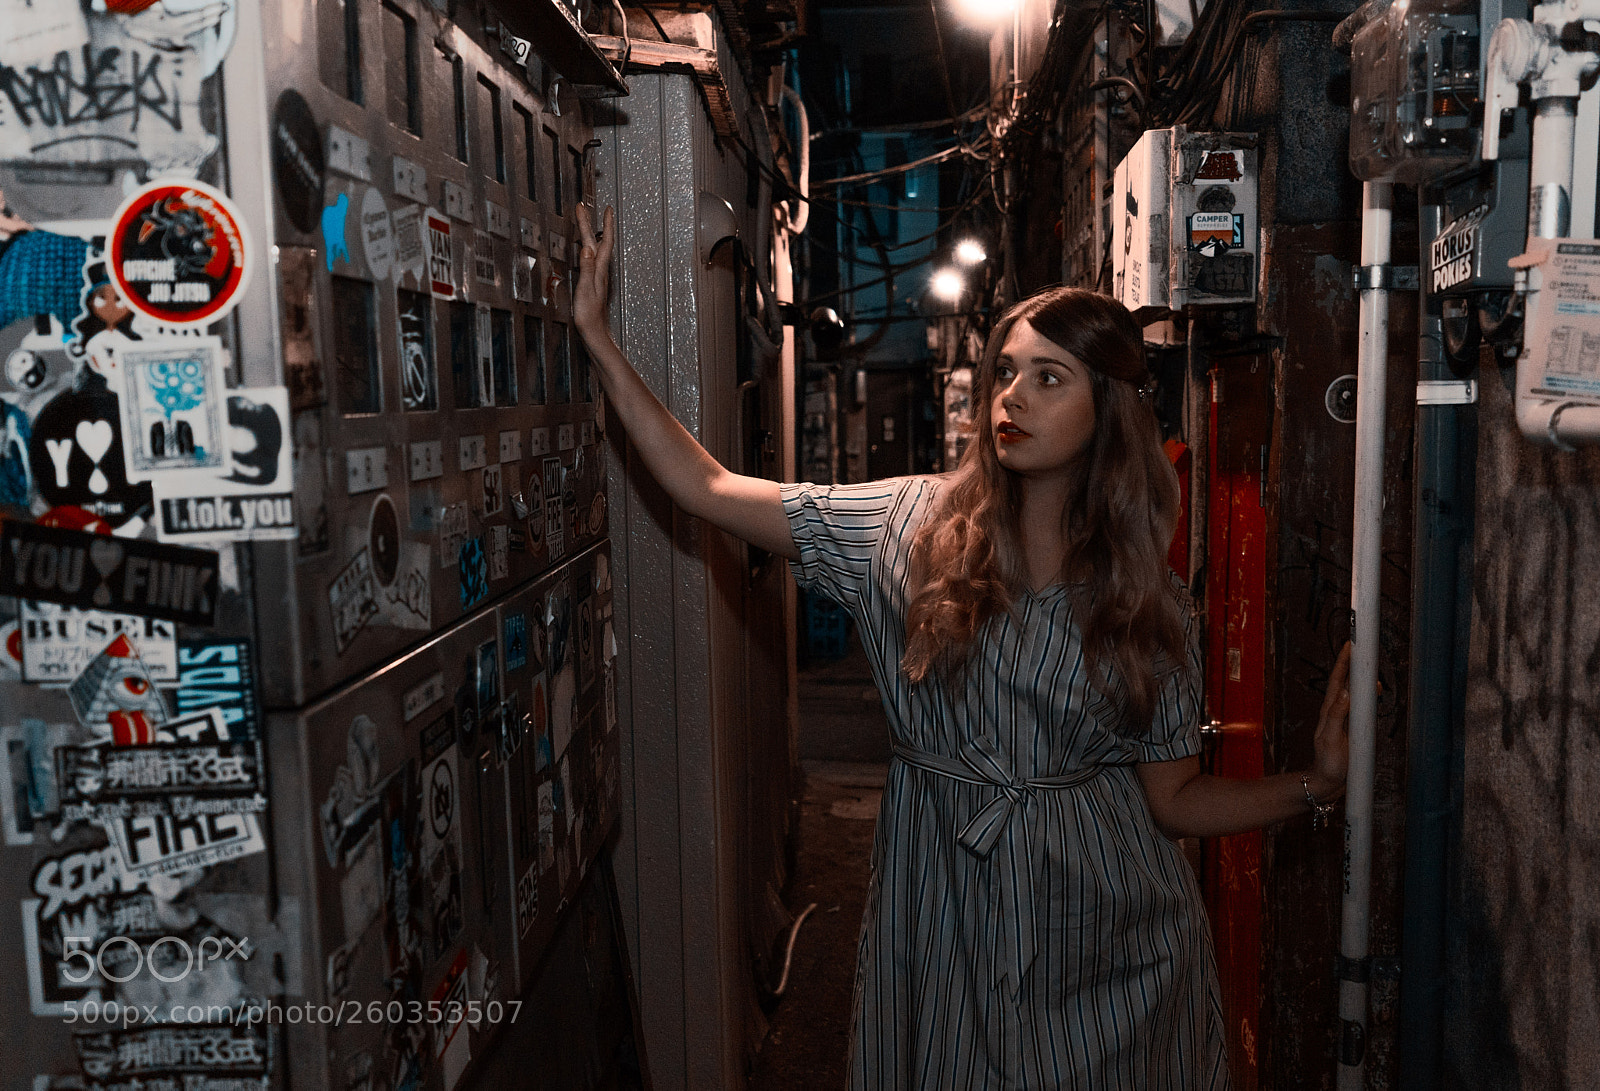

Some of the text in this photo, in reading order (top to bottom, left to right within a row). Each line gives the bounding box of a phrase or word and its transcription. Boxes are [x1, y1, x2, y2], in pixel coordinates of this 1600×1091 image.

[1197, 215, 1229, 223] CAMPER
[429, 229, 451, 261] VAN
[1434, 229, 1472, 267] HORUS
[431, 255, 452, 284] CITY
[1433, 253, 1473, 294] POKIES
[544, 460, 560, 498] HOT
[11, 539, 85, 593] YOU
